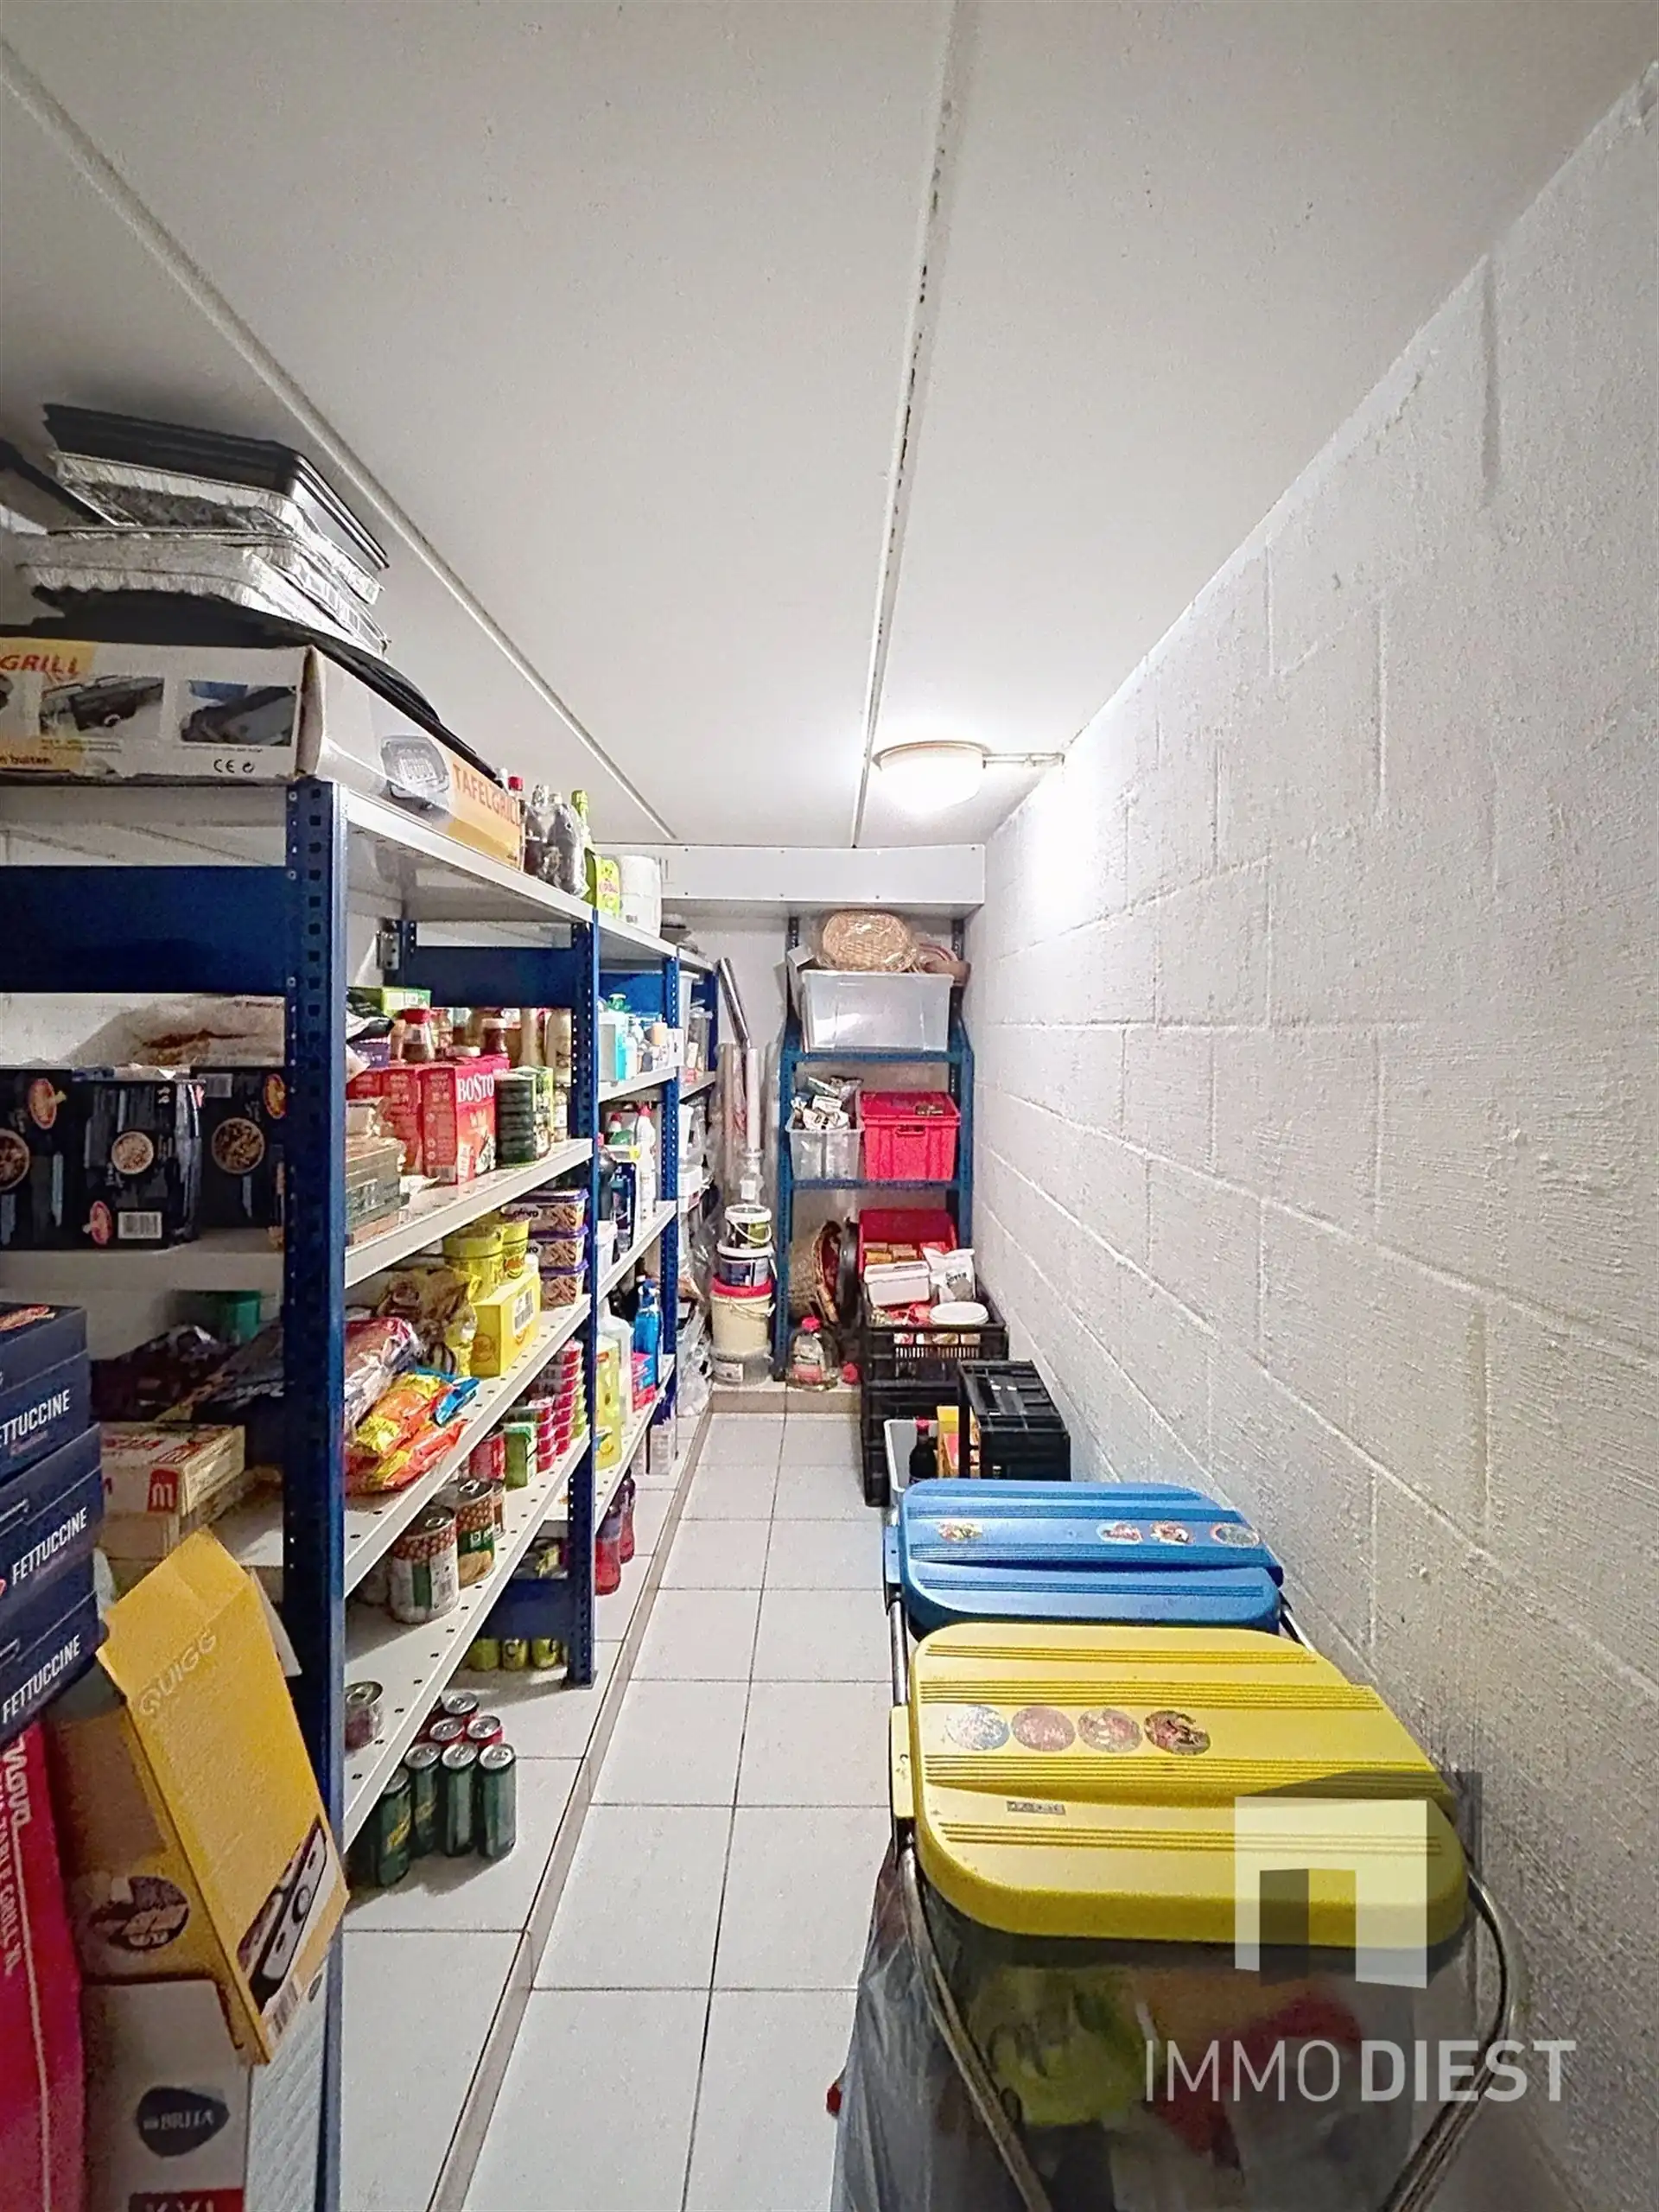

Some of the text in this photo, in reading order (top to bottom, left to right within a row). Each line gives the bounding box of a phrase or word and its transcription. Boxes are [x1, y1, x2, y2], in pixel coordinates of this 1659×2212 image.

[0, 654, 79, 675] GRILL
[456, 1073, 495, 1103] BOSTO
[0, 1389, 70, 1447] TTUCCINE
[12, 1506, 87, 1586] FETTUCCINE
[3, 1634, 81, 1724] FETTUCCINE
[139, 1626, 217, 1715] QUIGG
